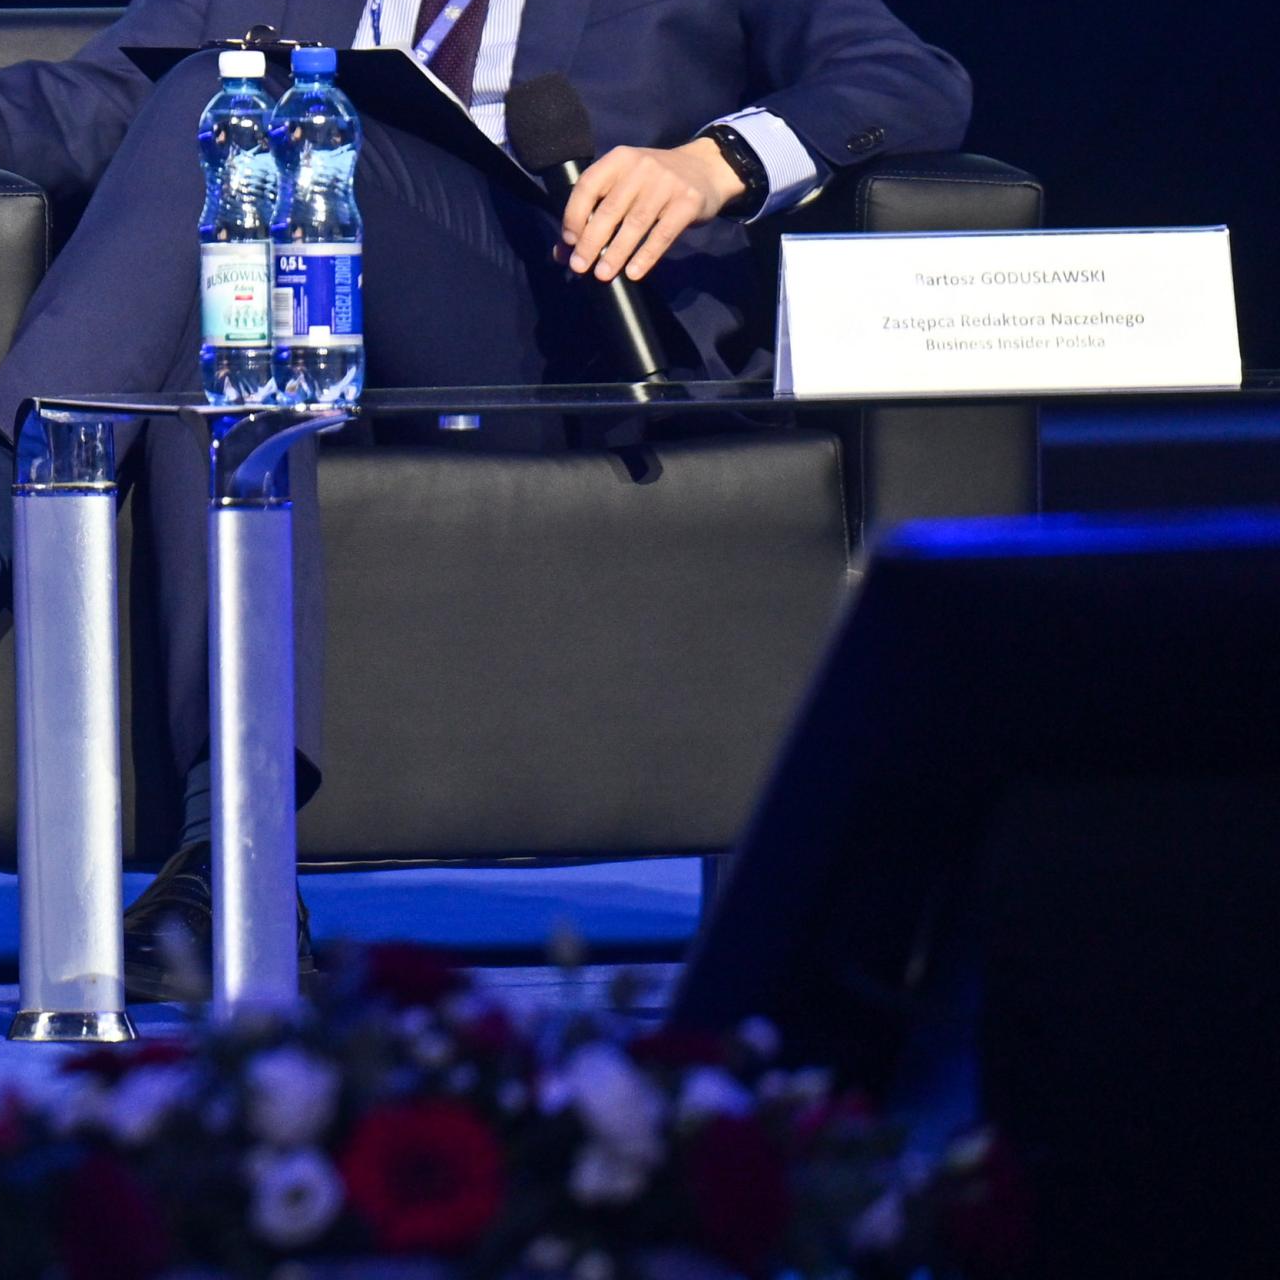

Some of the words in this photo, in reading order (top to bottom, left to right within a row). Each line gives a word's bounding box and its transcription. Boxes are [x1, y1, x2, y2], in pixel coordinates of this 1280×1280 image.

[280, 256, 297, 271] 0,5
[298, 256, 307, 270] L
[914, 272, 976, 287] Bartosz
[980, 269, 1106, 285] GODUSŁAWSKI
[882, 315, 955, 333] Zastępca
[960, 312, 1046, 328] Redaktora
[1050, 311, 1146, 328] Naczelnego
[925, 337, 993, 351] Business
[997, 336, 1051, 349] Insider
[1055, 334, 1107, 348] Polska
